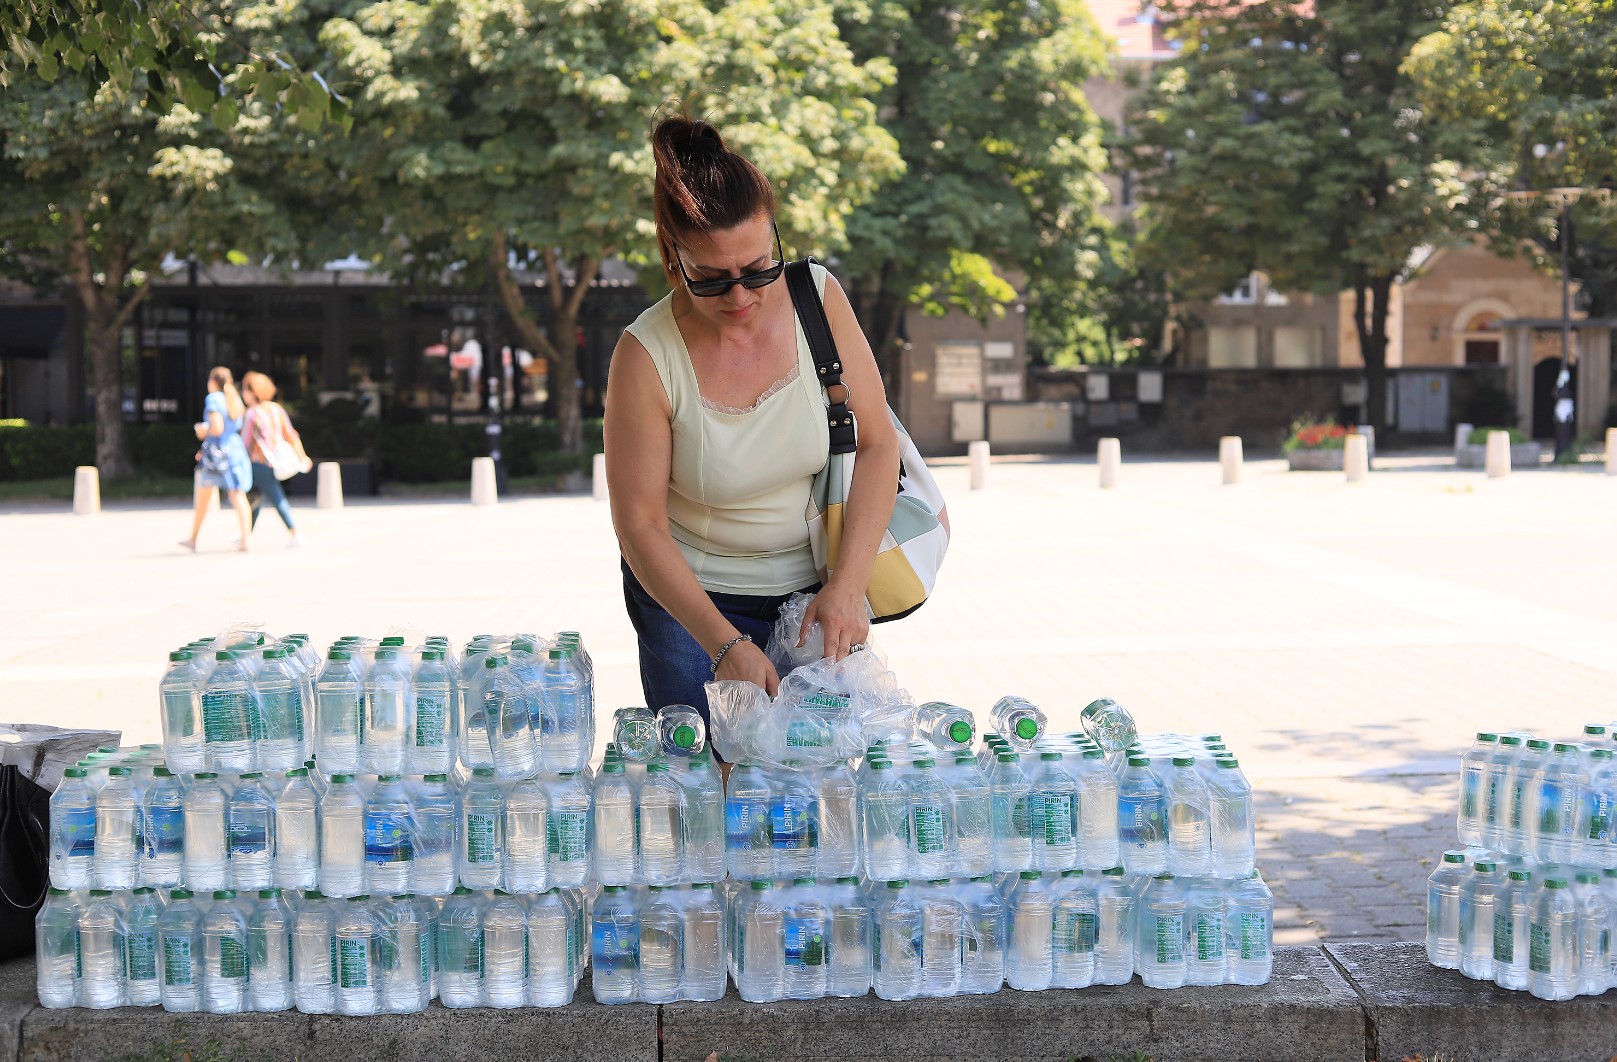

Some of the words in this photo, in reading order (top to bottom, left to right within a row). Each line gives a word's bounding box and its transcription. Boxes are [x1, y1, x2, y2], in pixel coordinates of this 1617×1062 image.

[1563, 788, 1572, 812] PIRIN
[1599, 794, 1607, 817] PIRIN
[560, 813, 578, 821] PIRIN
[741, 805, 749, 828] PIRIN
[784, 800, 792, 827] PIRIN
[1134, 803, 1142, 827] PIRIN
[146, 814, 154, 839] PIRIN
[376, 820, 384, 845] PIRIN
